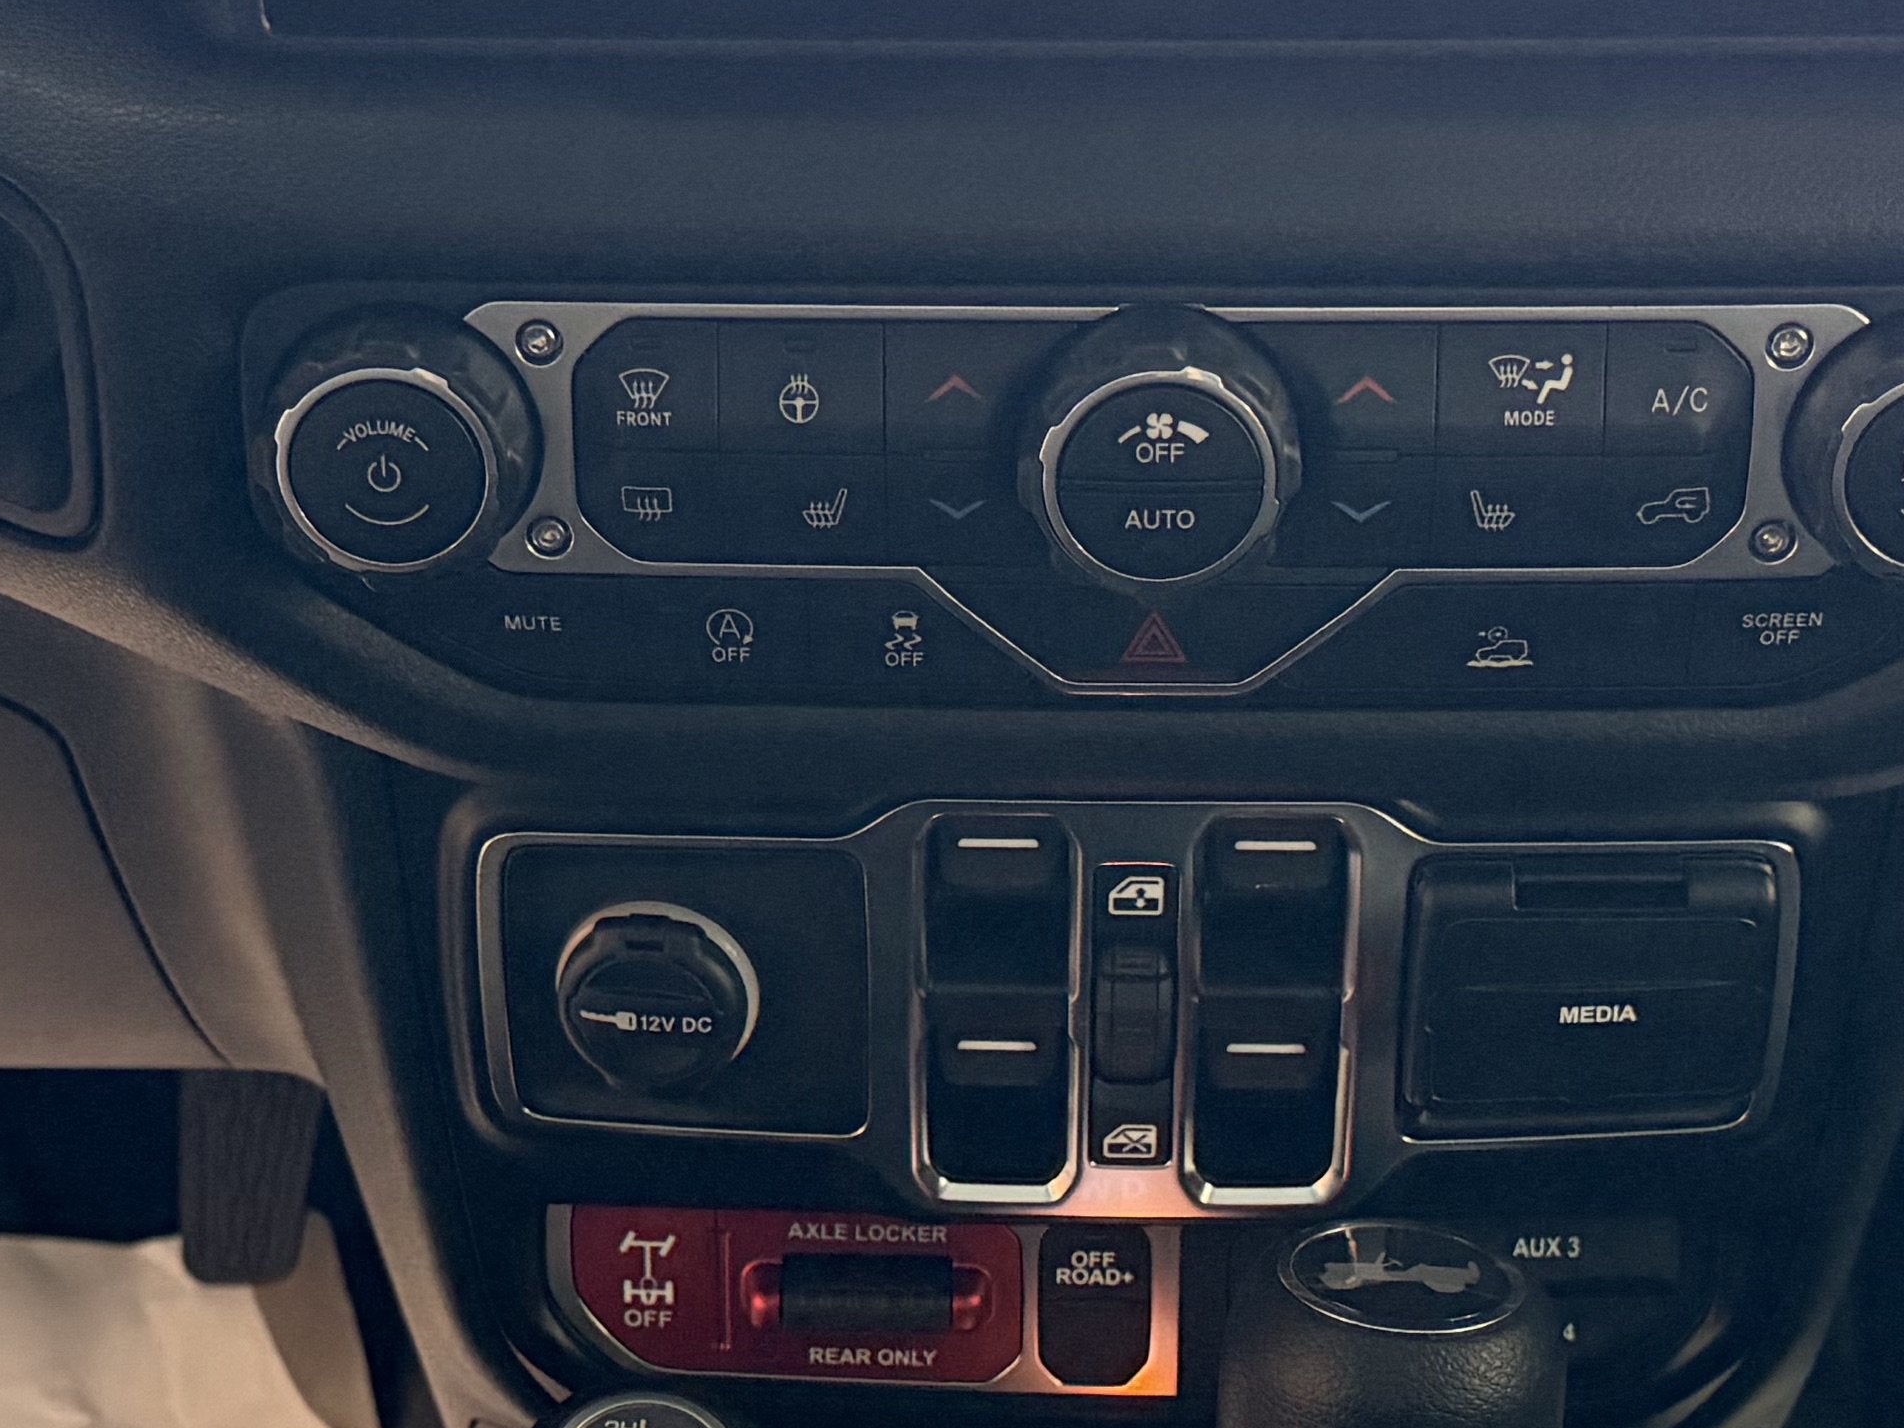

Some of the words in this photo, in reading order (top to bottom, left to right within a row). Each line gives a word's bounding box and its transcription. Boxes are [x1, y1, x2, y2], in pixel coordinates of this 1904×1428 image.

[1651, 386, 1709, 416] A/C
[615, 410, 672, 428] FRONT
[1503, 410, 1556, 428] MODE
[343, 420, 417, 445] VOLUME
[1135, 443, 1186, 465] OFF
[1124, 509, 1195, 531] AUTO
[504, 615, 563, 633] MUTE
[1741, 611, 1824, 630] SCREEN
[1758, 629, 1802, 646] OFF
[711, 647, 752, 664] OFF
[884, 651, 924, 667] OFF
[638, 1014, 676, 1033] 12V
[681, 1016, 714, 1034] DC
[1558, 1004, 1637, 1025] MEDIA
[788, 1222, 848, 1241] AXLE
[854, 1224, 948, 1244] LOCKER
[1512, 1236, 1564, 1260] AUX
[1569, 1237, 1582, 1260] 3
[1070, 1249, 1116, 1269] OFF
[623, 1308, 673, 1329] OFF
[808, 1346, 872, 1365] REAR
[876, 1348, 939, 1367] ONLY
